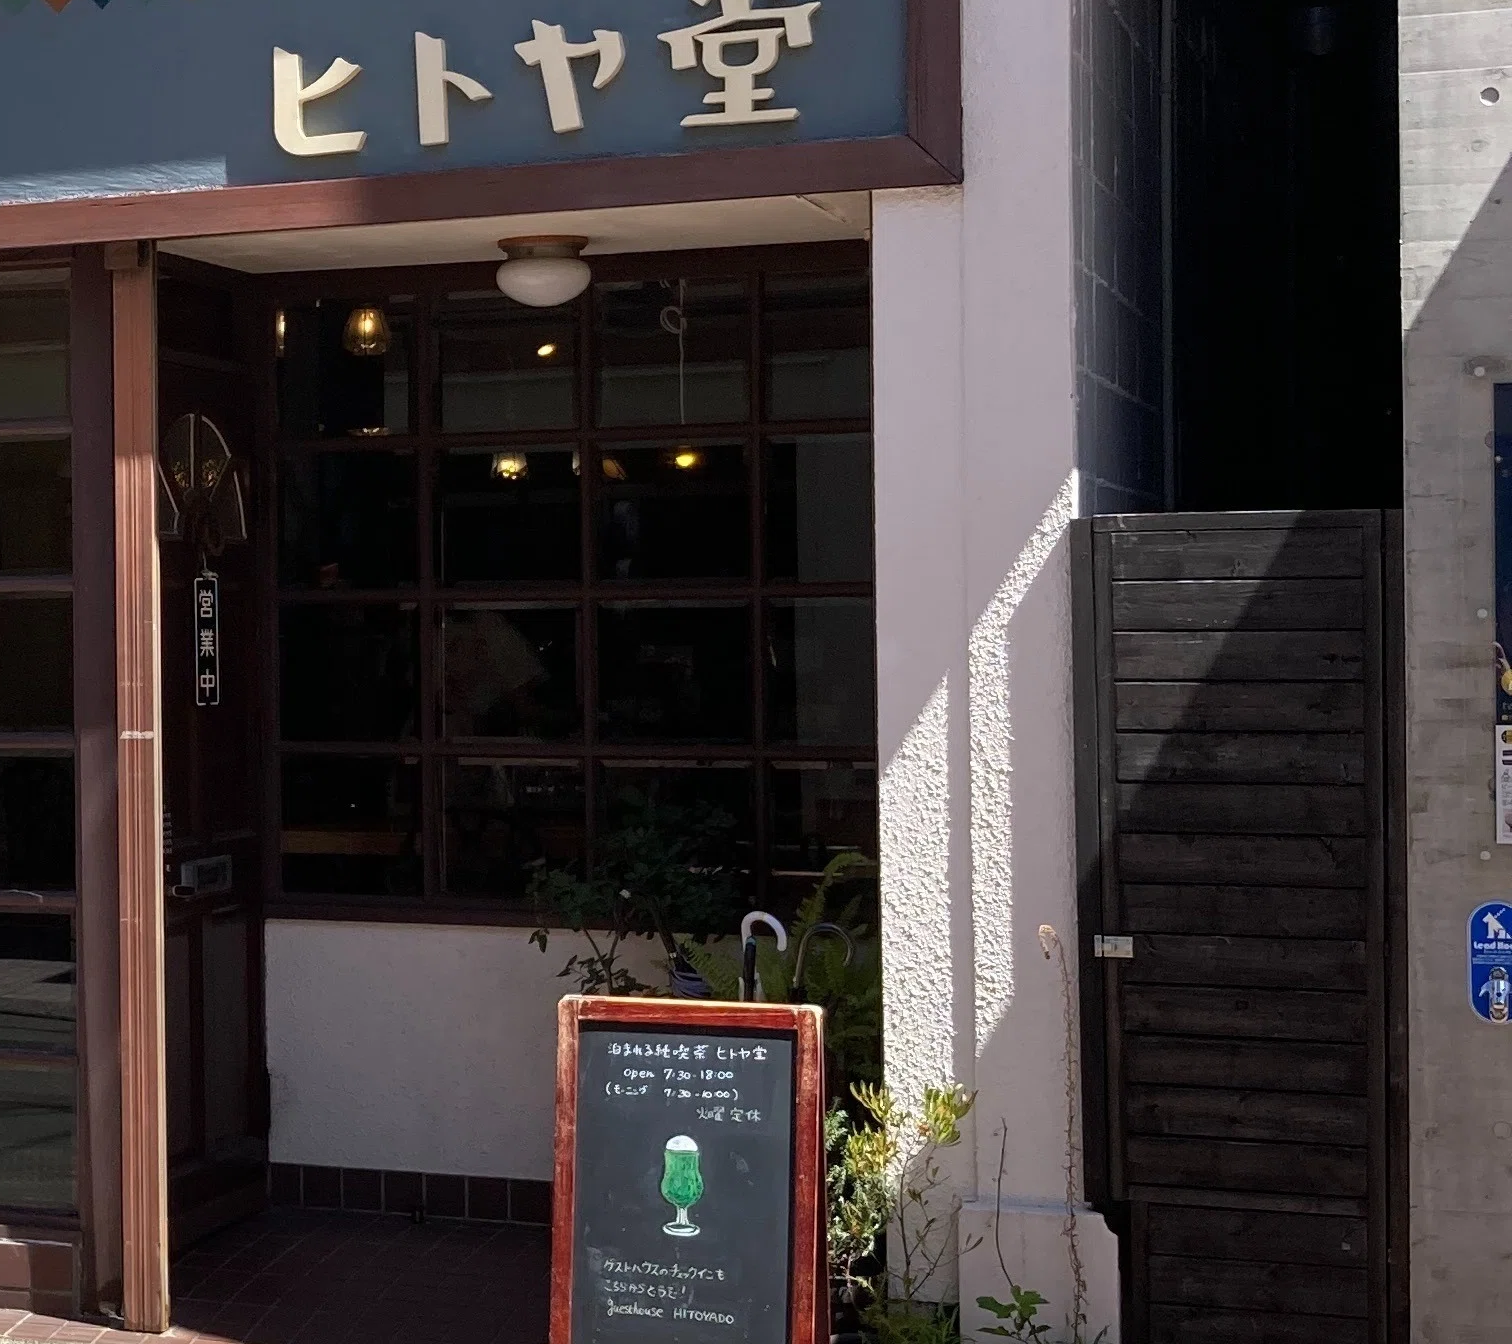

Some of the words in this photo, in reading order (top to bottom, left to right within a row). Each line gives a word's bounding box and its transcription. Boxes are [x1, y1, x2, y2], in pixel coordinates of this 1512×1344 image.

[199, 588, 216, 698] 営業中
[716, 1045, 768, 1061] ヒトヤ堂
[673, 1307, 735, 1324] HITOYADO
